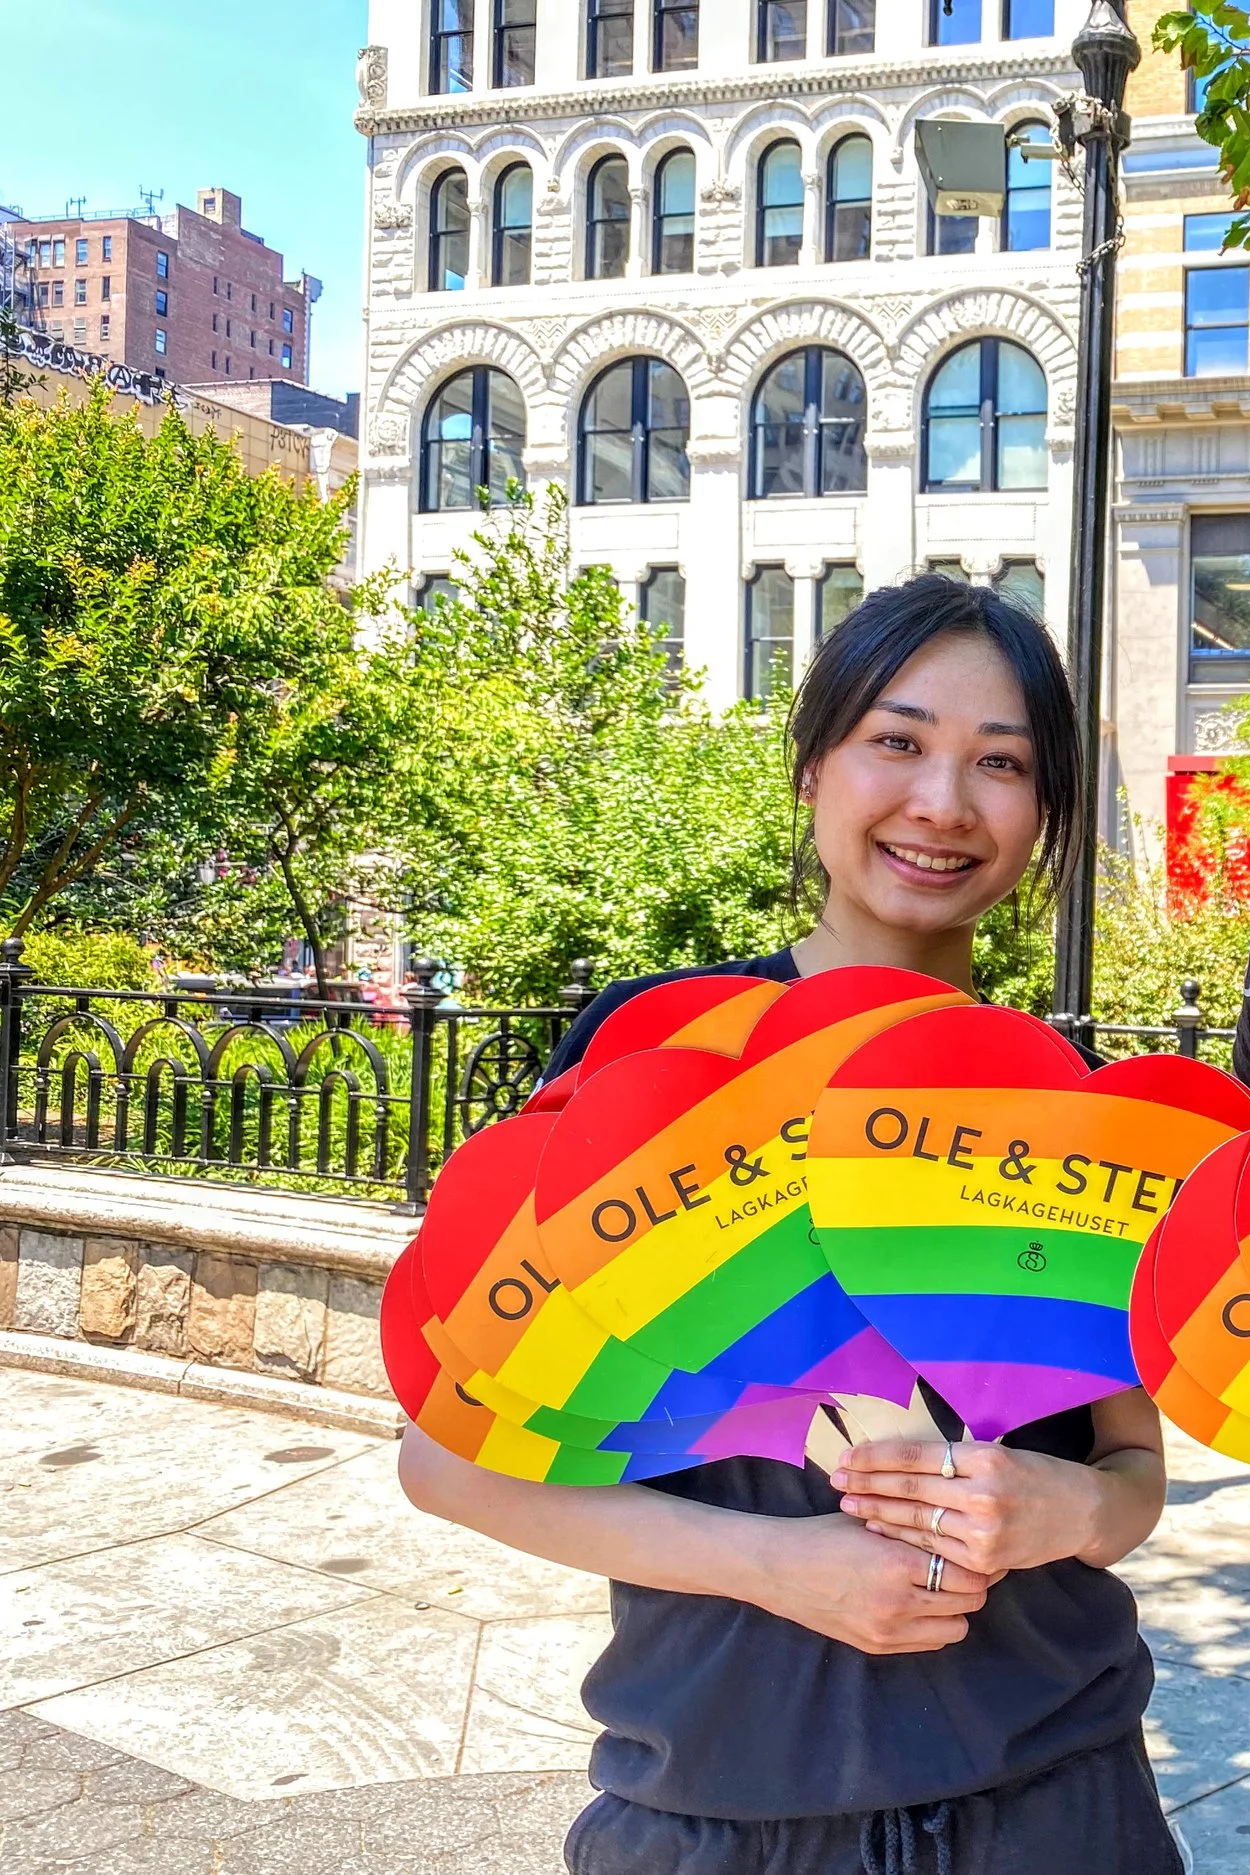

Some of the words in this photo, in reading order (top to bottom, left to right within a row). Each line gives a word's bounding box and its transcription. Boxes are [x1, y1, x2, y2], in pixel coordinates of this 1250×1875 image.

[865, 1108, 982, 1170] OLE
[999, 1140, 1036, 1185] &
[592, 1164, 711, 1242] OLE
[724, 1144, 771, 1186] &
[960, 1185, 1129, 1236] LAGKAGEHUSET
